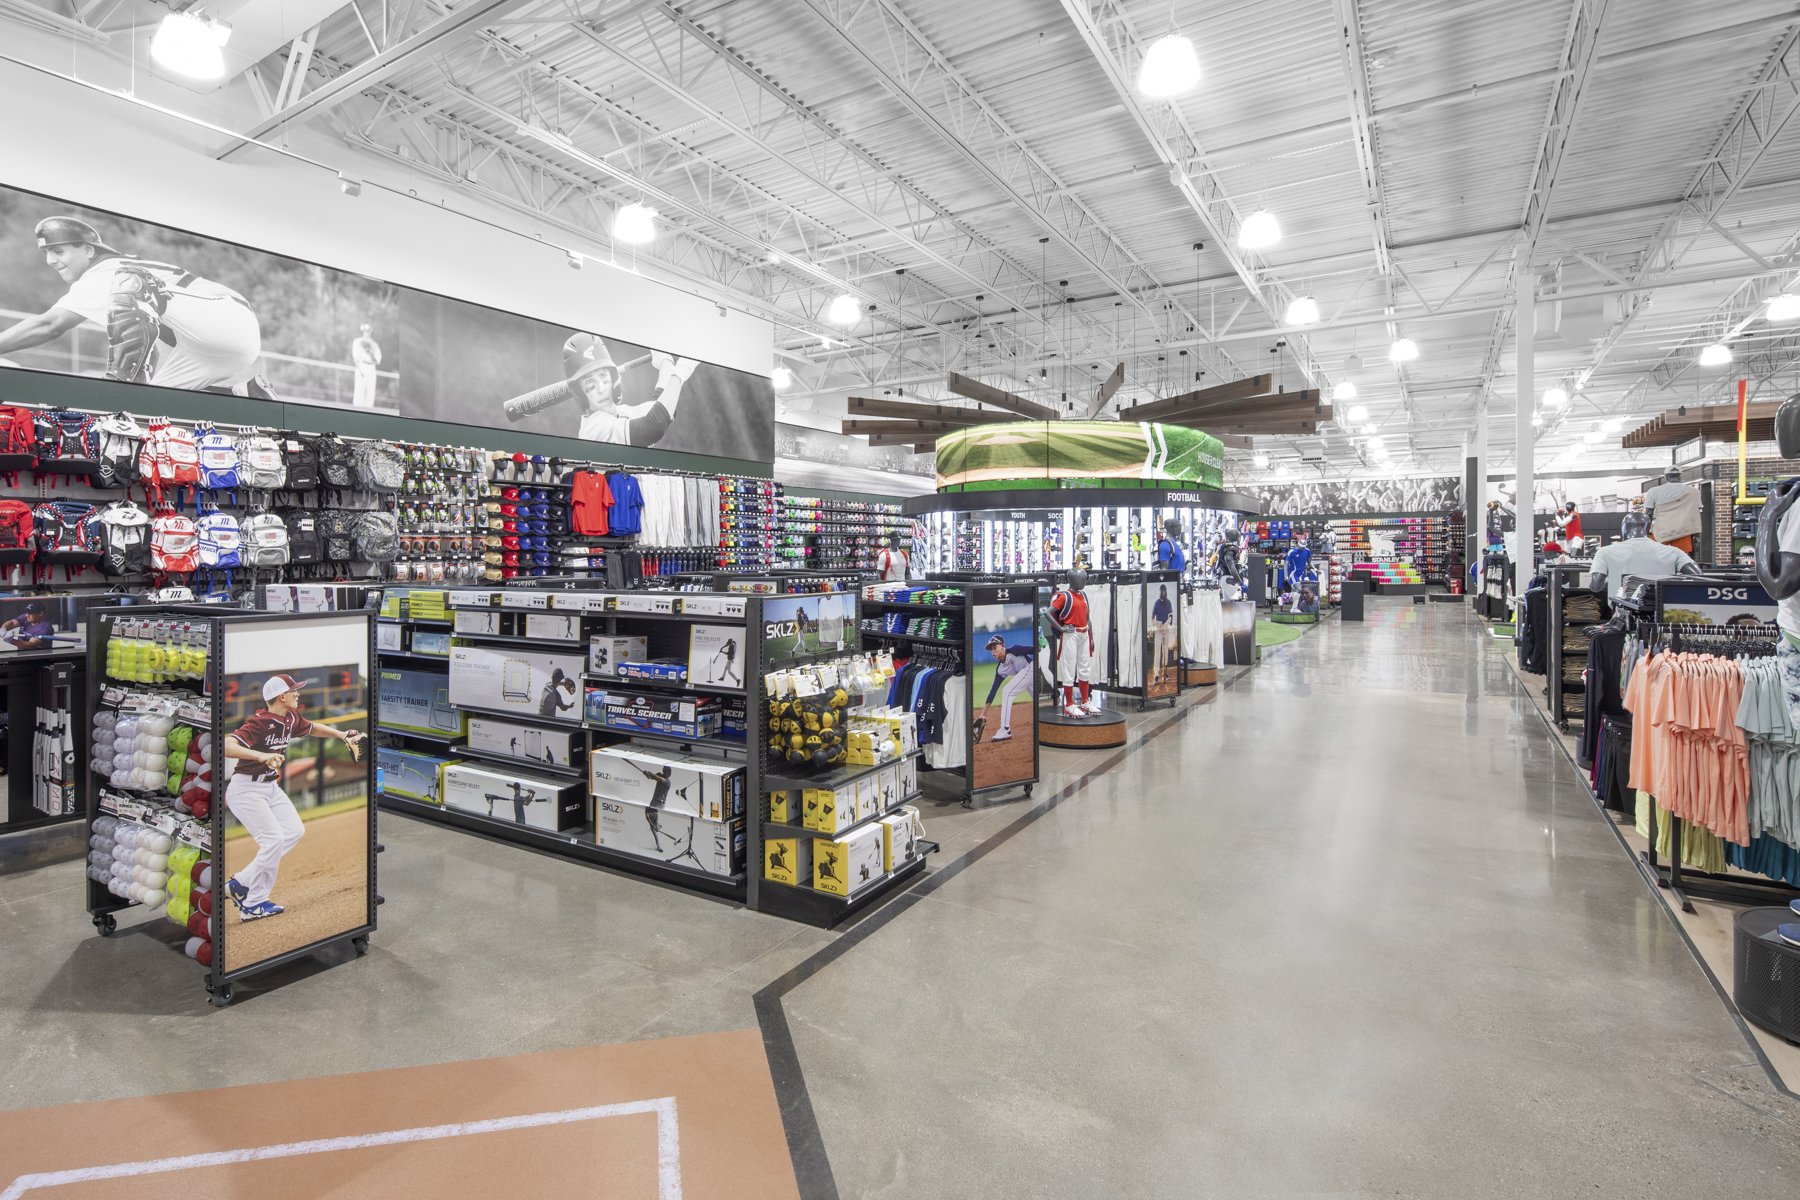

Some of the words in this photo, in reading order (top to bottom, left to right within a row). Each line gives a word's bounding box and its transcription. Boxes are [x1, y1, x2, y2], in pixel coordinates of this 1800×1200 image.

[1167, 492, 1201, 503] FOOTBALL
[1707, 587, 1748, 600] DSG
[766, 622, 794, 639] SKLZ
[381, 694, 402, 704] VARSITY
[403, 697, 428, 707] TRAINER
[607, 704, 637, 716] TRAVEL
[637, 710, 673, 720] SCREEN
[596, 771, 609, 780] SKLZ
[602, 802, 620, 813] SKLZ
[772, 872, 785, 880] SKLZ
[820, 882, 835, 891] SKLZ
